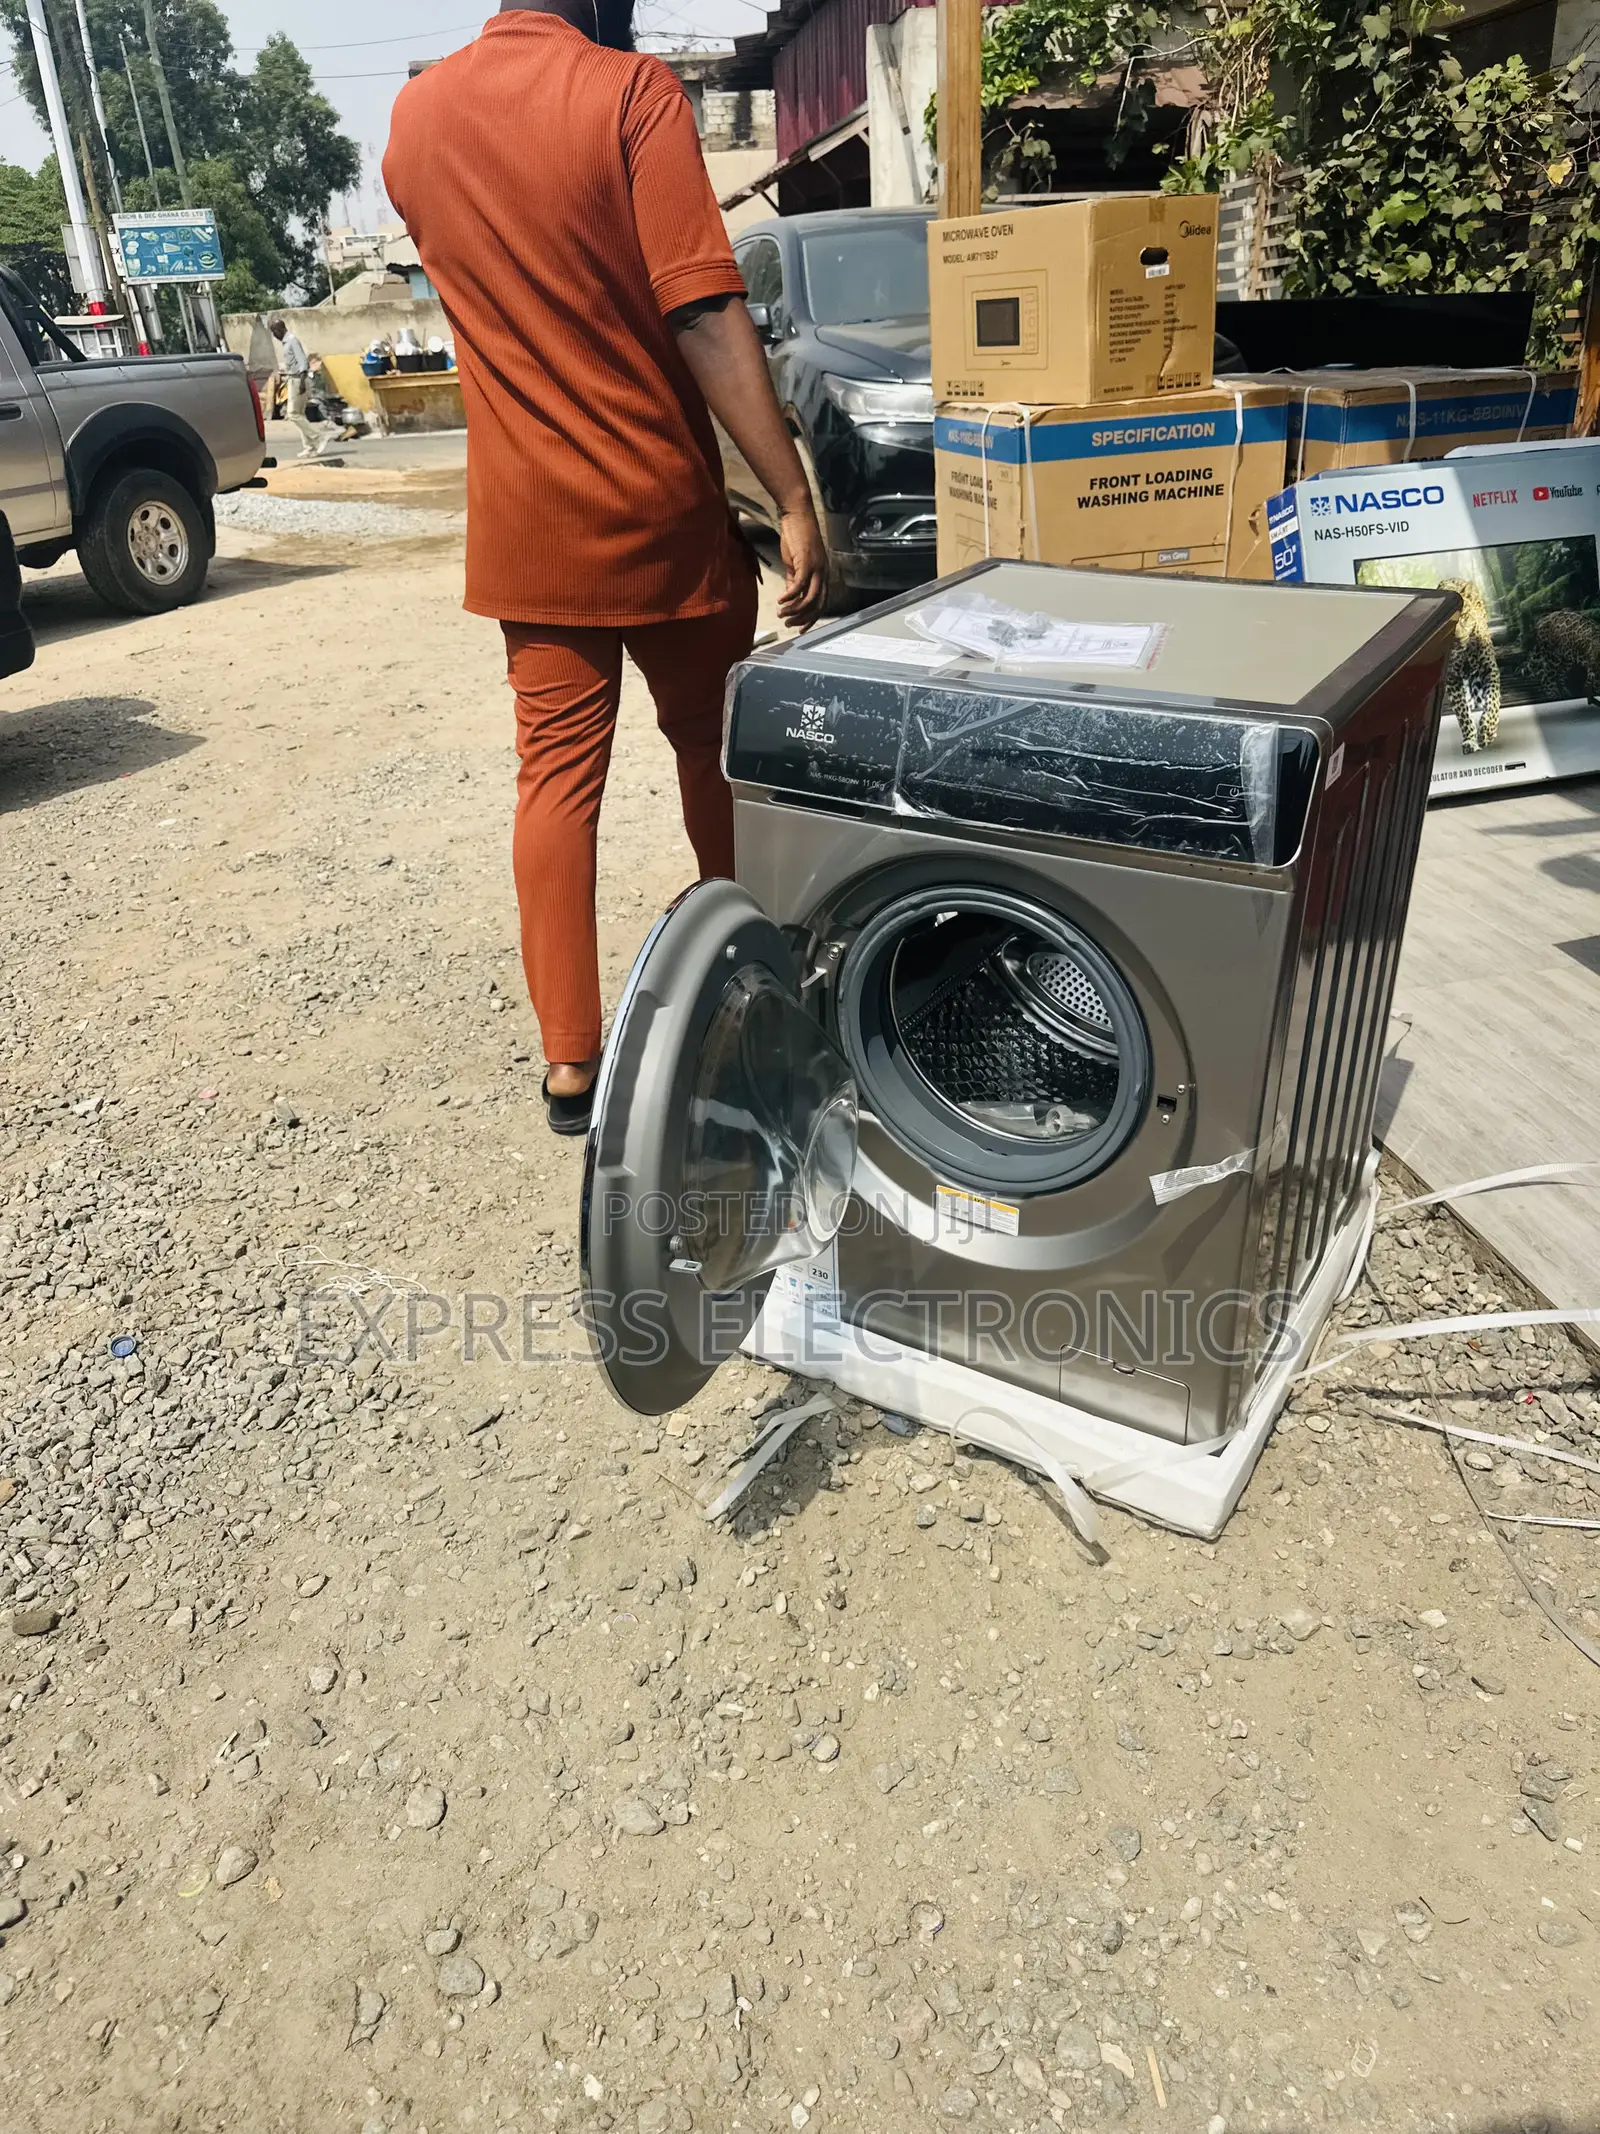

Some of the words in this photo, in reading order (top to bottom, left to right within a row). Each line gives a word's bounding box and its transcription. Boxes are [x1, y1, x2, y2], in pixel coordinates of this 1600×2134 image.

[943, 226, 989, 242] MICROWAVE
[991, 224, 1014, 237] OVEN
[1091, 422, 1215, 447] SPECIFICATION
[1089, 474, 1140, 490] FRONT
[1145, 467, 1213, 485] LOADING
[1077, 491, 1149, 509] WASHING
[1154, 484, 1225, 501] MACHINE
[1334, 485, 1444, 514] NASCO
[1472, 489, 1518, 508] NETFLIX
[1550, 485, 1583, 498] YouTube
[1314, 520, 1409, 541] NAS-H50FS-VID
[786, 727, 835, 744] NASCO
[1459, 770, 1473, 778] AND
[1473, 765, 1504, 776] DECODER
[812, 1267, 829, 1280] 230
